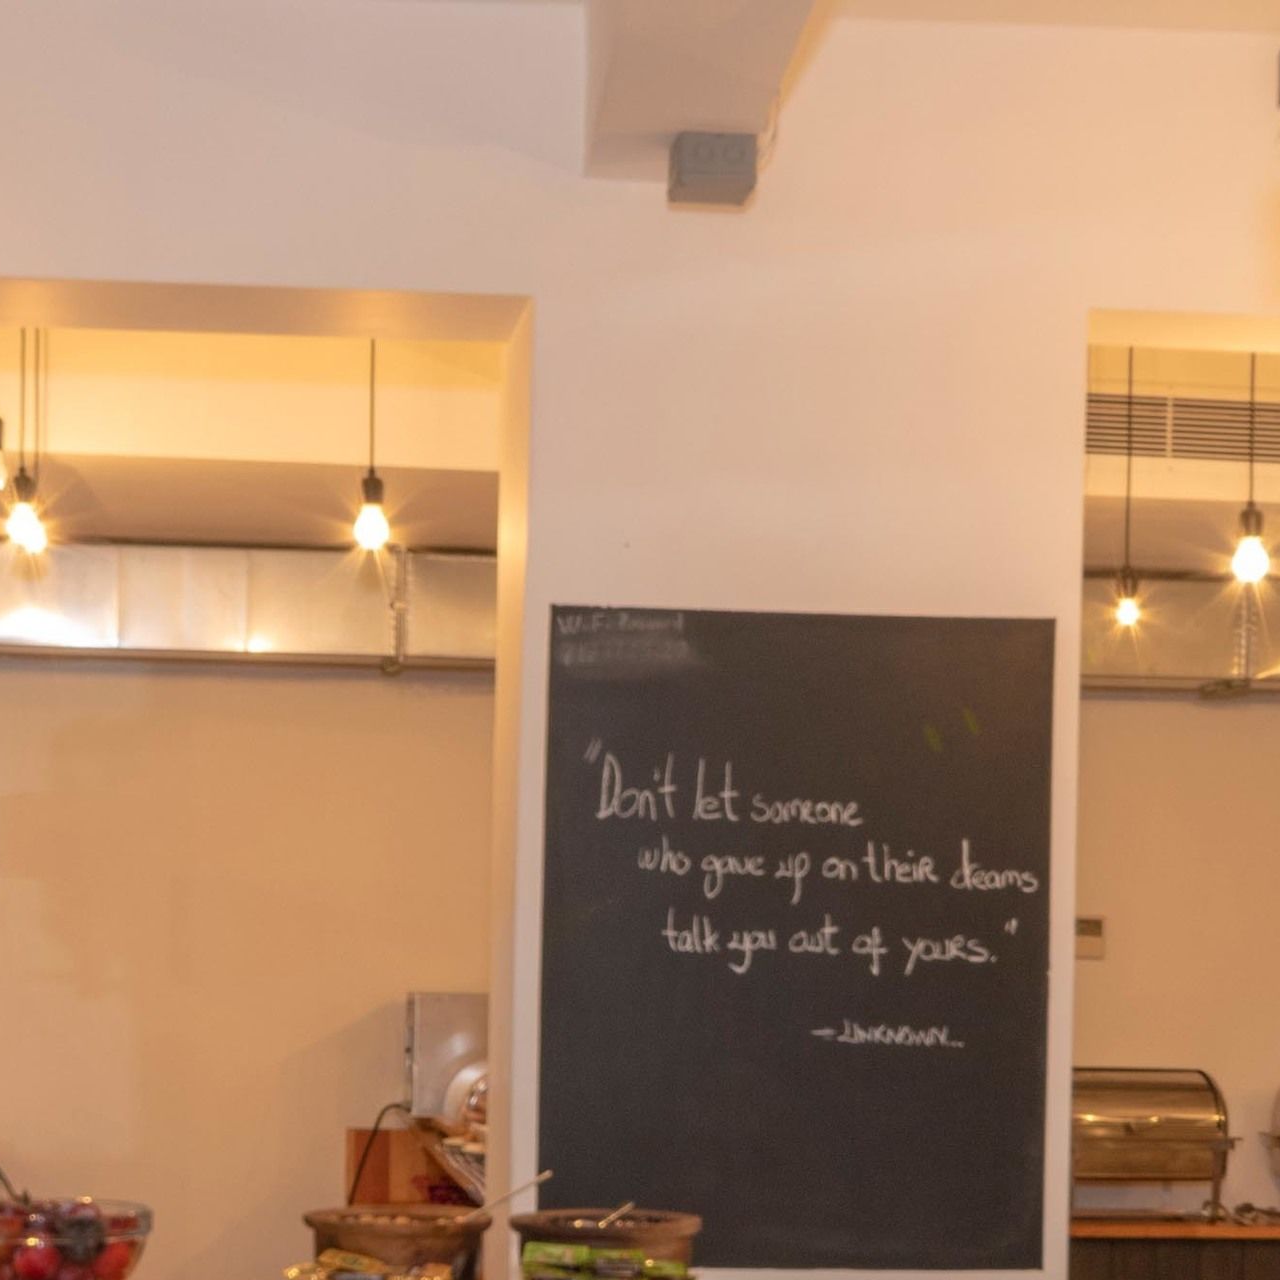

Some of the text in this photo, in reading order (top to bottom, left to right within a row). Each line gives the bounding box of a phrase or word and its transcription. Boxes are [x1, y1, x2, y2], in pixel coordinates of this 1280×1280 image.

[691, 757, 740, 822] let
[750, 792, 864, 826] someone
[637, 834, 691, 876] who
[700, 853, 766, 899] gave
[773, 851, 811, 905] up
[821, 856, 859, 881] on
[862, 840, 939, 884] their
[661, 905, 720, 954] talk
[726, 928, 777, 975] you
[787, 913, 840, 956] out
[852, 925, 888, 977] of
